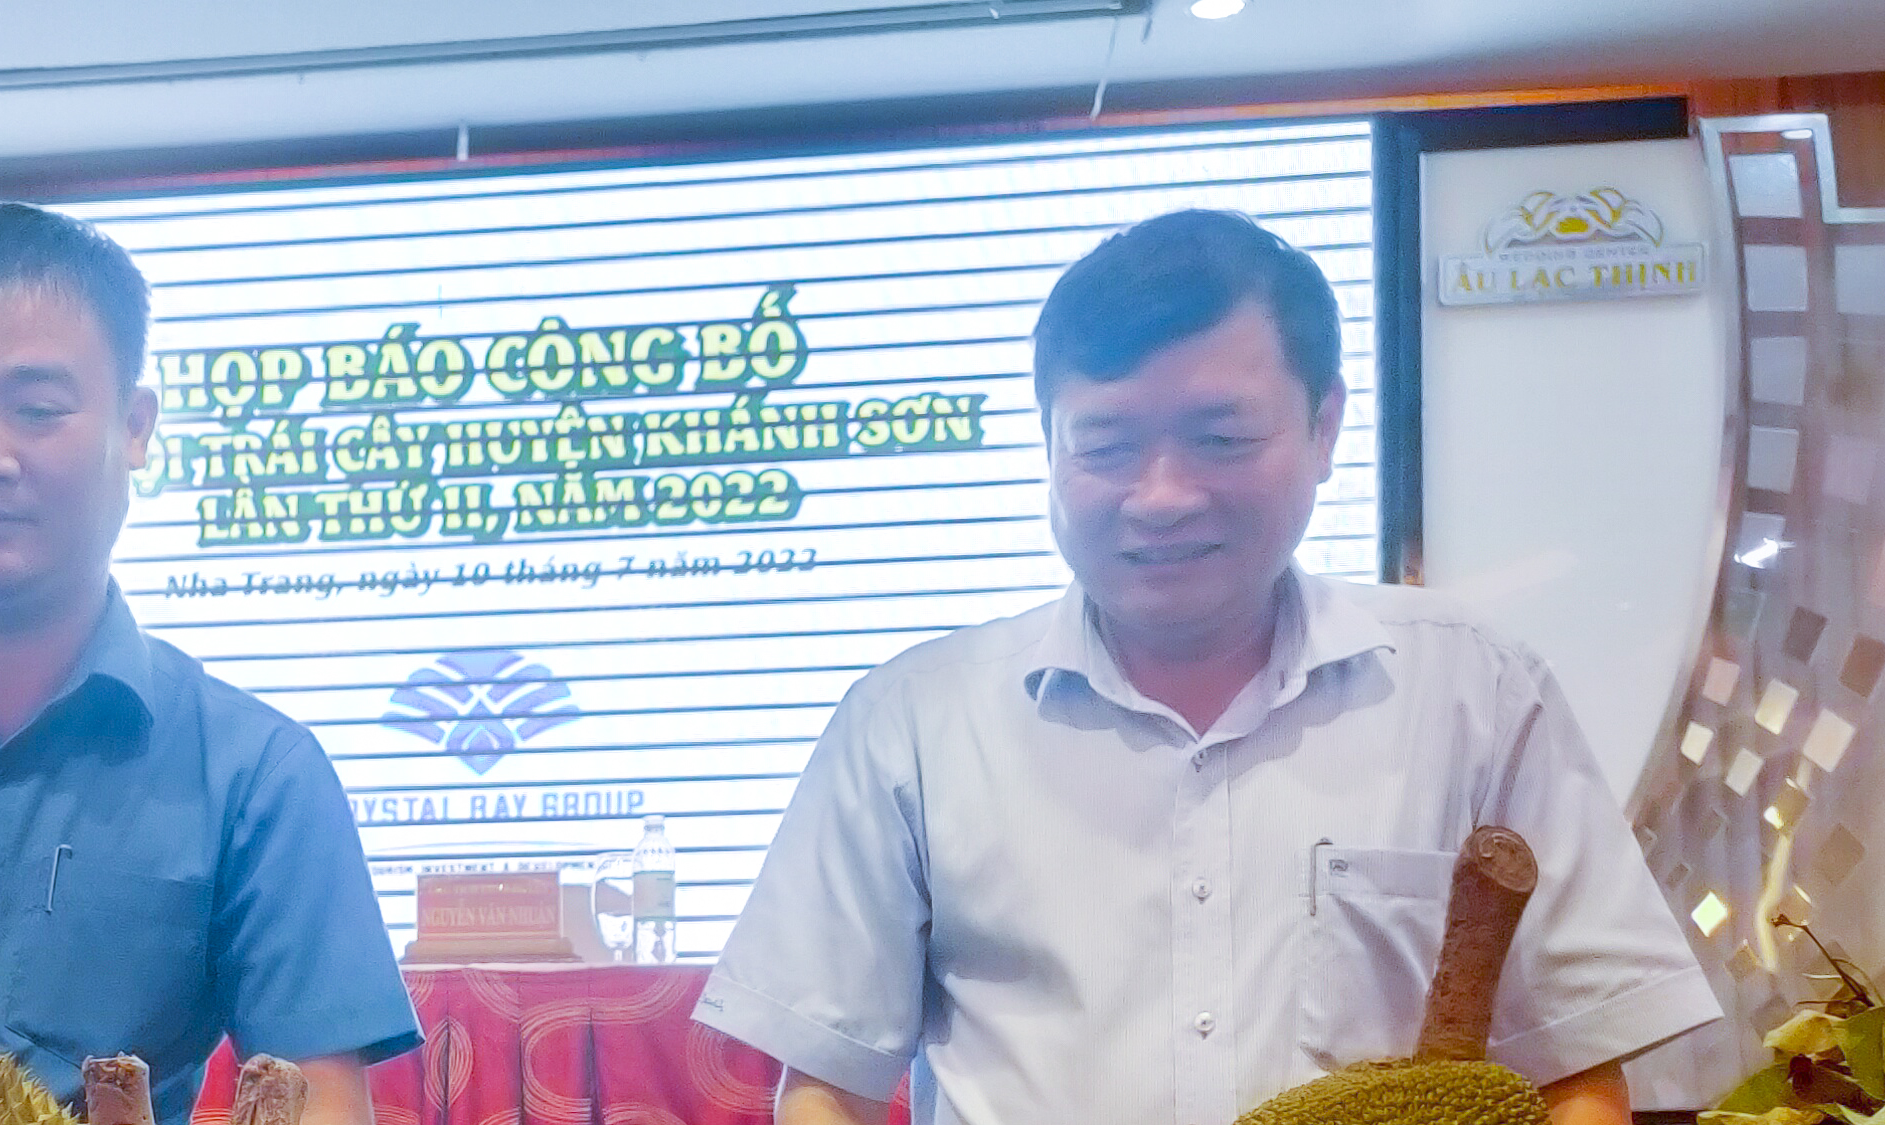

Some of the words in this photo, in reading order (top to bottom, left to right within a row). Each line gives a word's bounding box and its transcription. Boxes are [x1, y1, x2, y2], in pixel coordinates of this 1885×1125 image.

[159, 347, 306, 418] HỌP
[324, 325, 467, 402] BÁO
[485, 317, 678, 392] CÔNG
[698, 290, 800, 381] BỐ
[198, 419, 318, 478] TRÁI
[335, 414, 430, 473] CÂY
[444, 404, 627, 469] HUYỆN
[644, 394, 841, 457] KHÁNH
[857, 393, 974, 447] SƠN
[200, 474, 301, 540] LẦN
[314, 479, 429, 535] THỨ
[517, 471, 641, 526] NĂM
[654, 468, 791, 520] 2022
[166, 572, 228, 598] Nha
[242, 570, 344, 600] Trang,
[359, 561, 441, 597] ngày
[453, 562, 491, 586] 10
[504, 555, 603, 590] tháng
[618, 555, 637, 580] 7
[647, 551, 722, 578] năm
[733, 547, 818, 573] 2022
[348, 795, 449, 823] YSTAL
